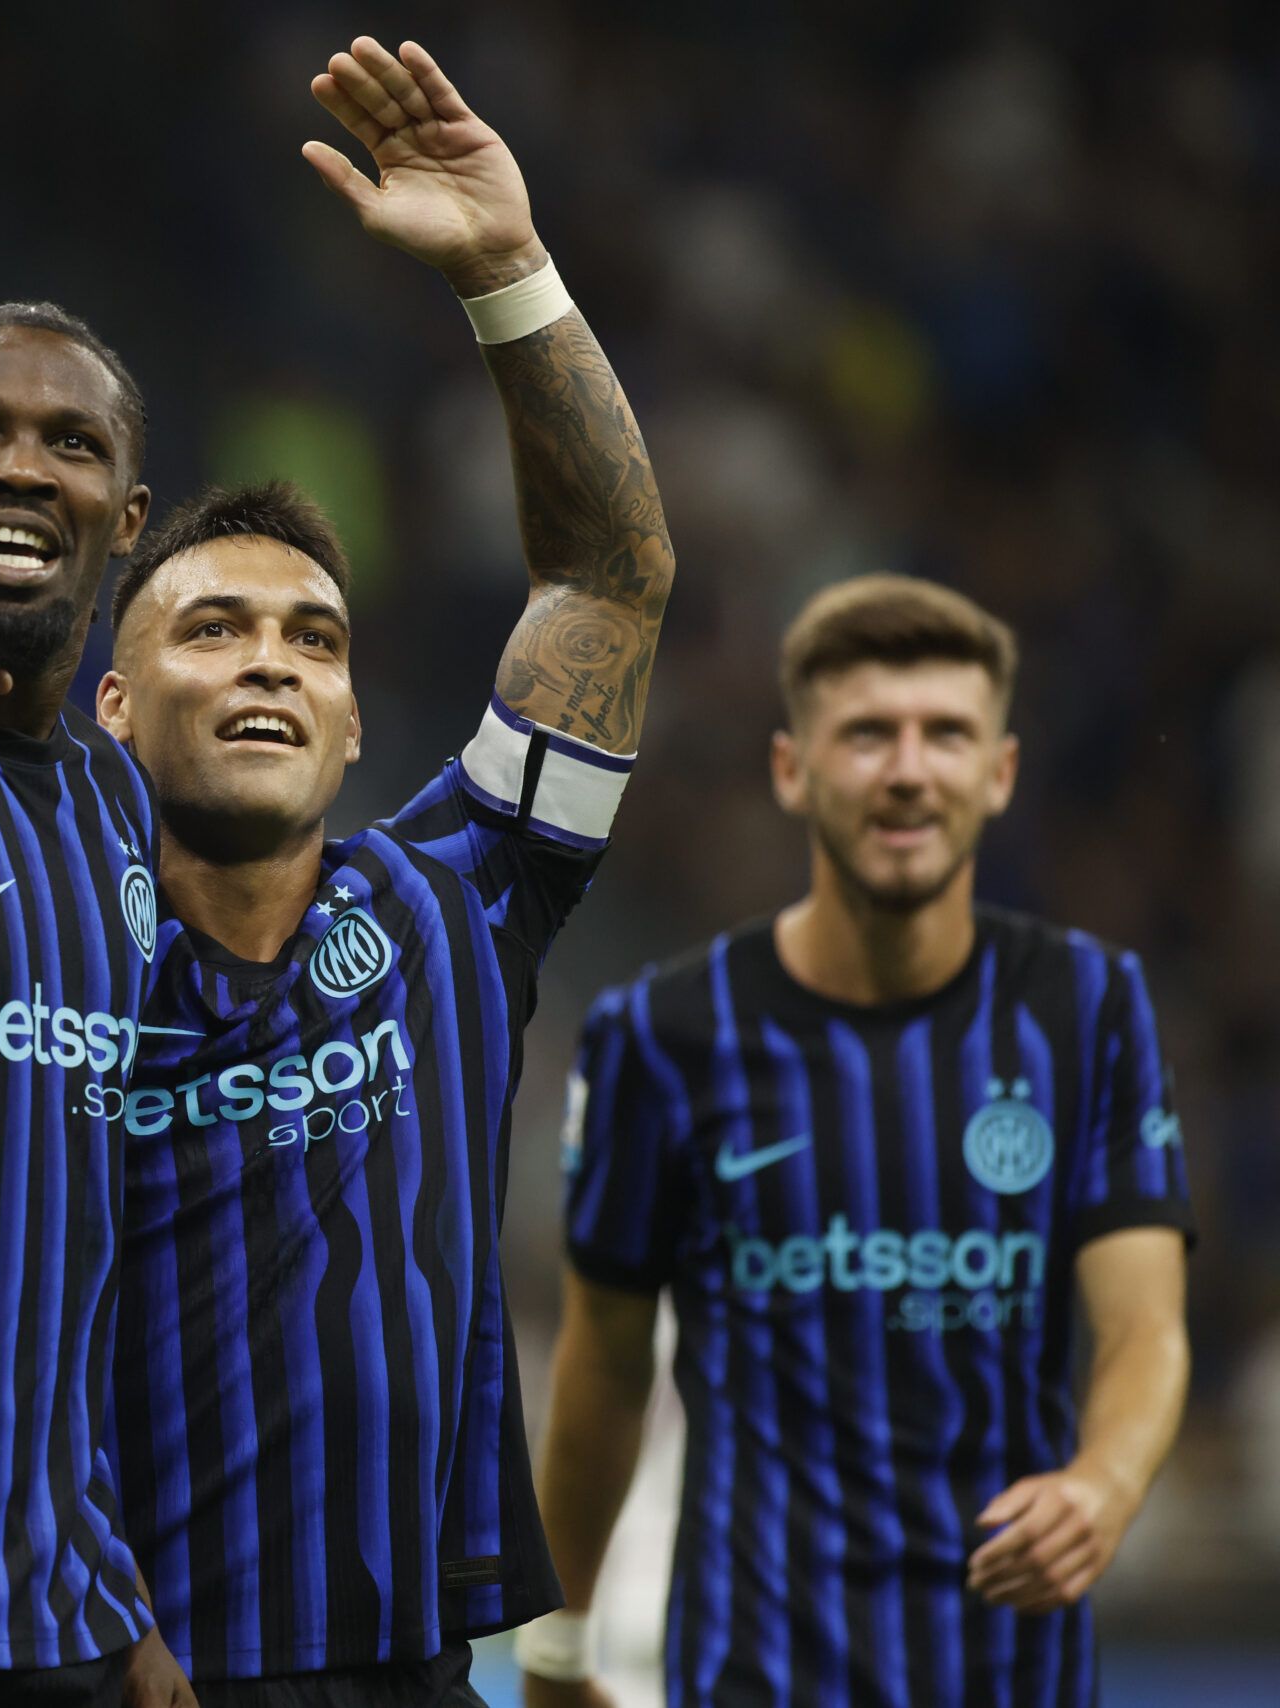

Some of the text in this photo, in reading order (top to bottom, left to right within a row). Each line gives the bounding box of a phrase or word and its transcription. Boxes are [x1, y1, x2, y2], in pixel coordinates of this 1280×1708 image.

[124, 1019, 411, 1137] etsson
[255, 1075, 411, 1154] sport
[724, 1212, 1044, 1293] betsson
